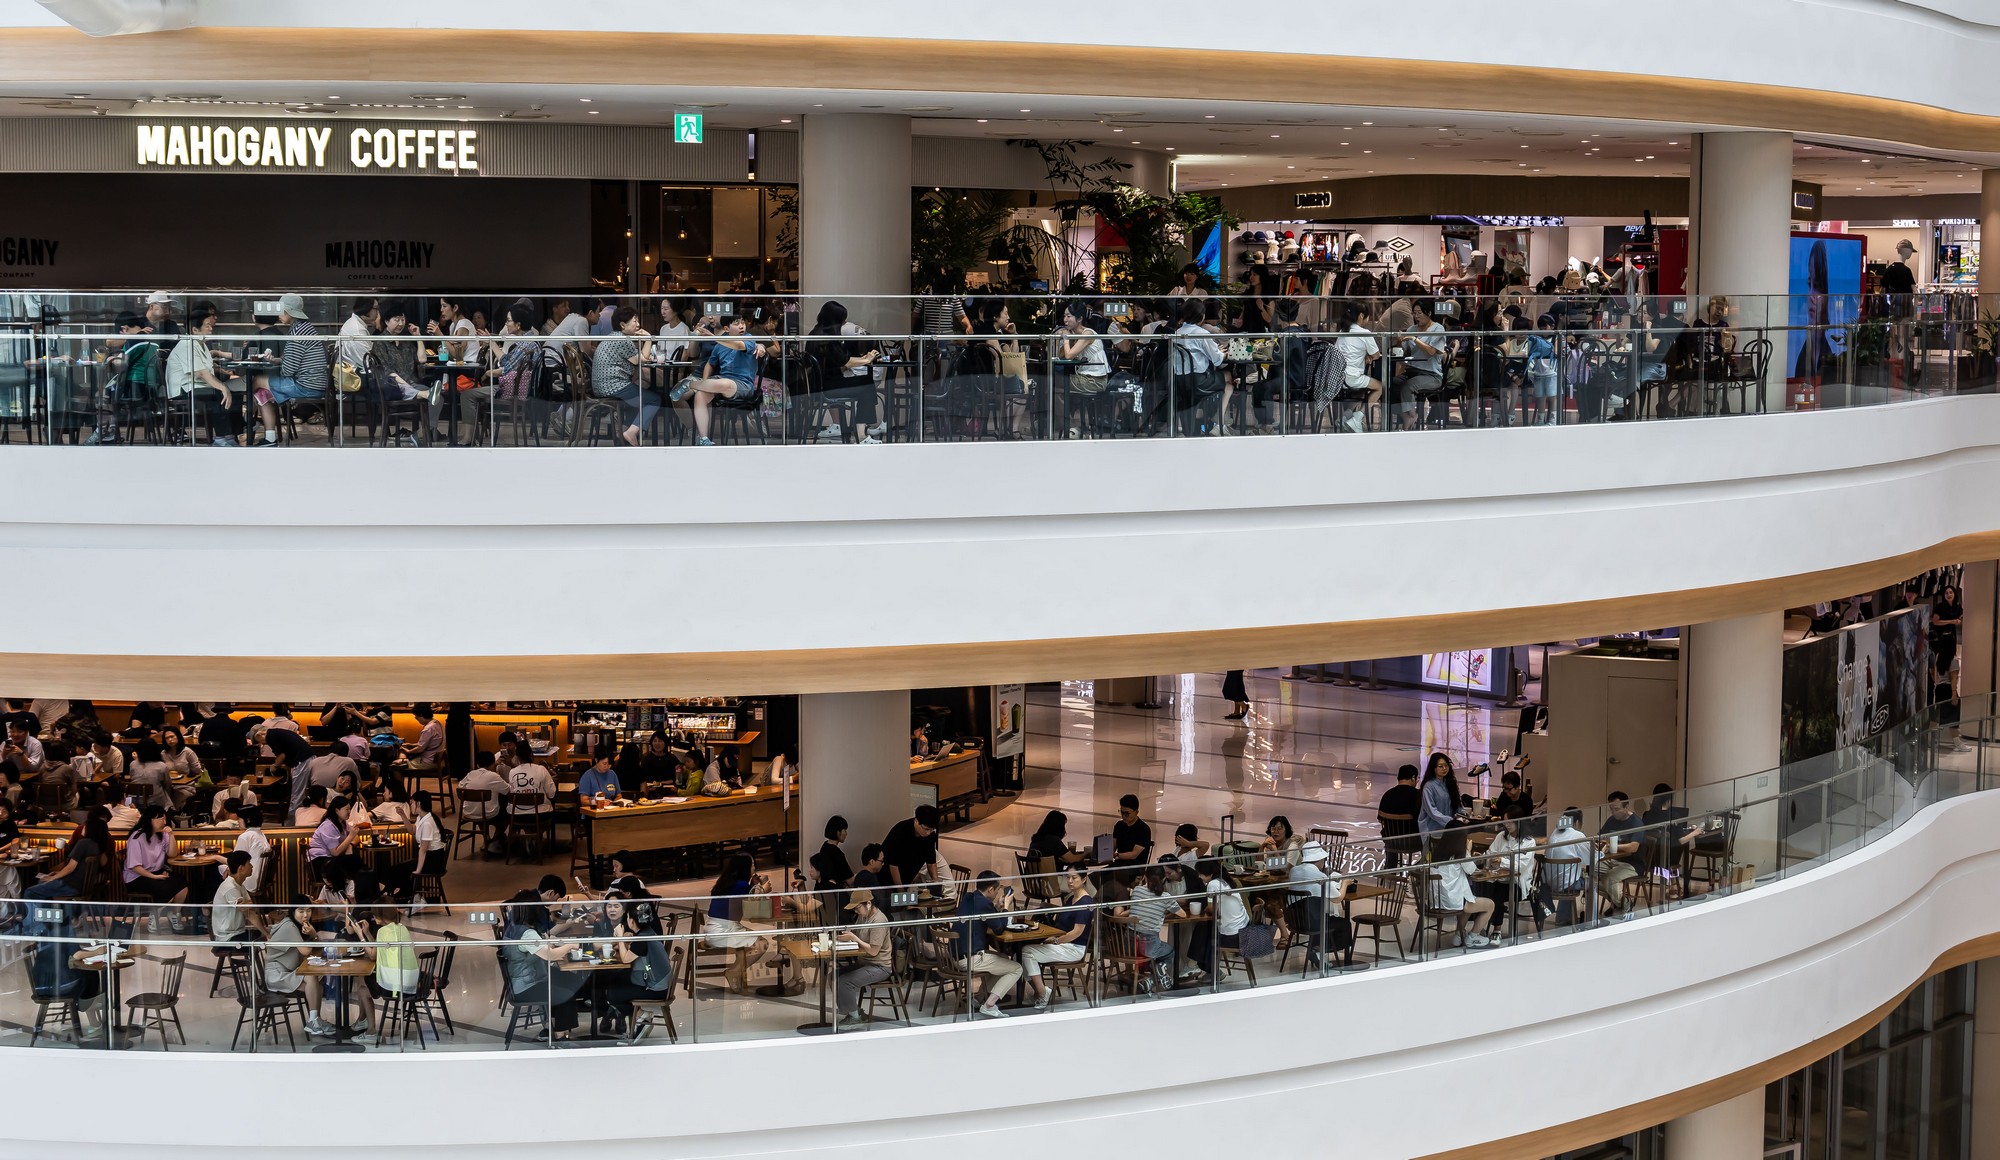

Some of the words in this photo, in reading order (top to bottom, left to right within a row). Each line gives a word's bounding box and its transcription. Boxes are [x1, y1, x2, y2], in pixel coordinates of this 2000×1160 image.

[137, 125, 332, 166] MAHOGANY
[350, 127, 478, 169] COFFEE
[0, 236, 59, 266] GANY
[325, 239, 435, 268] MAHOGANY
[1837, 657, 1868, 685] Change
[1840, 692, 1857, 716] Your
[512, 772, 535, 787] Be
